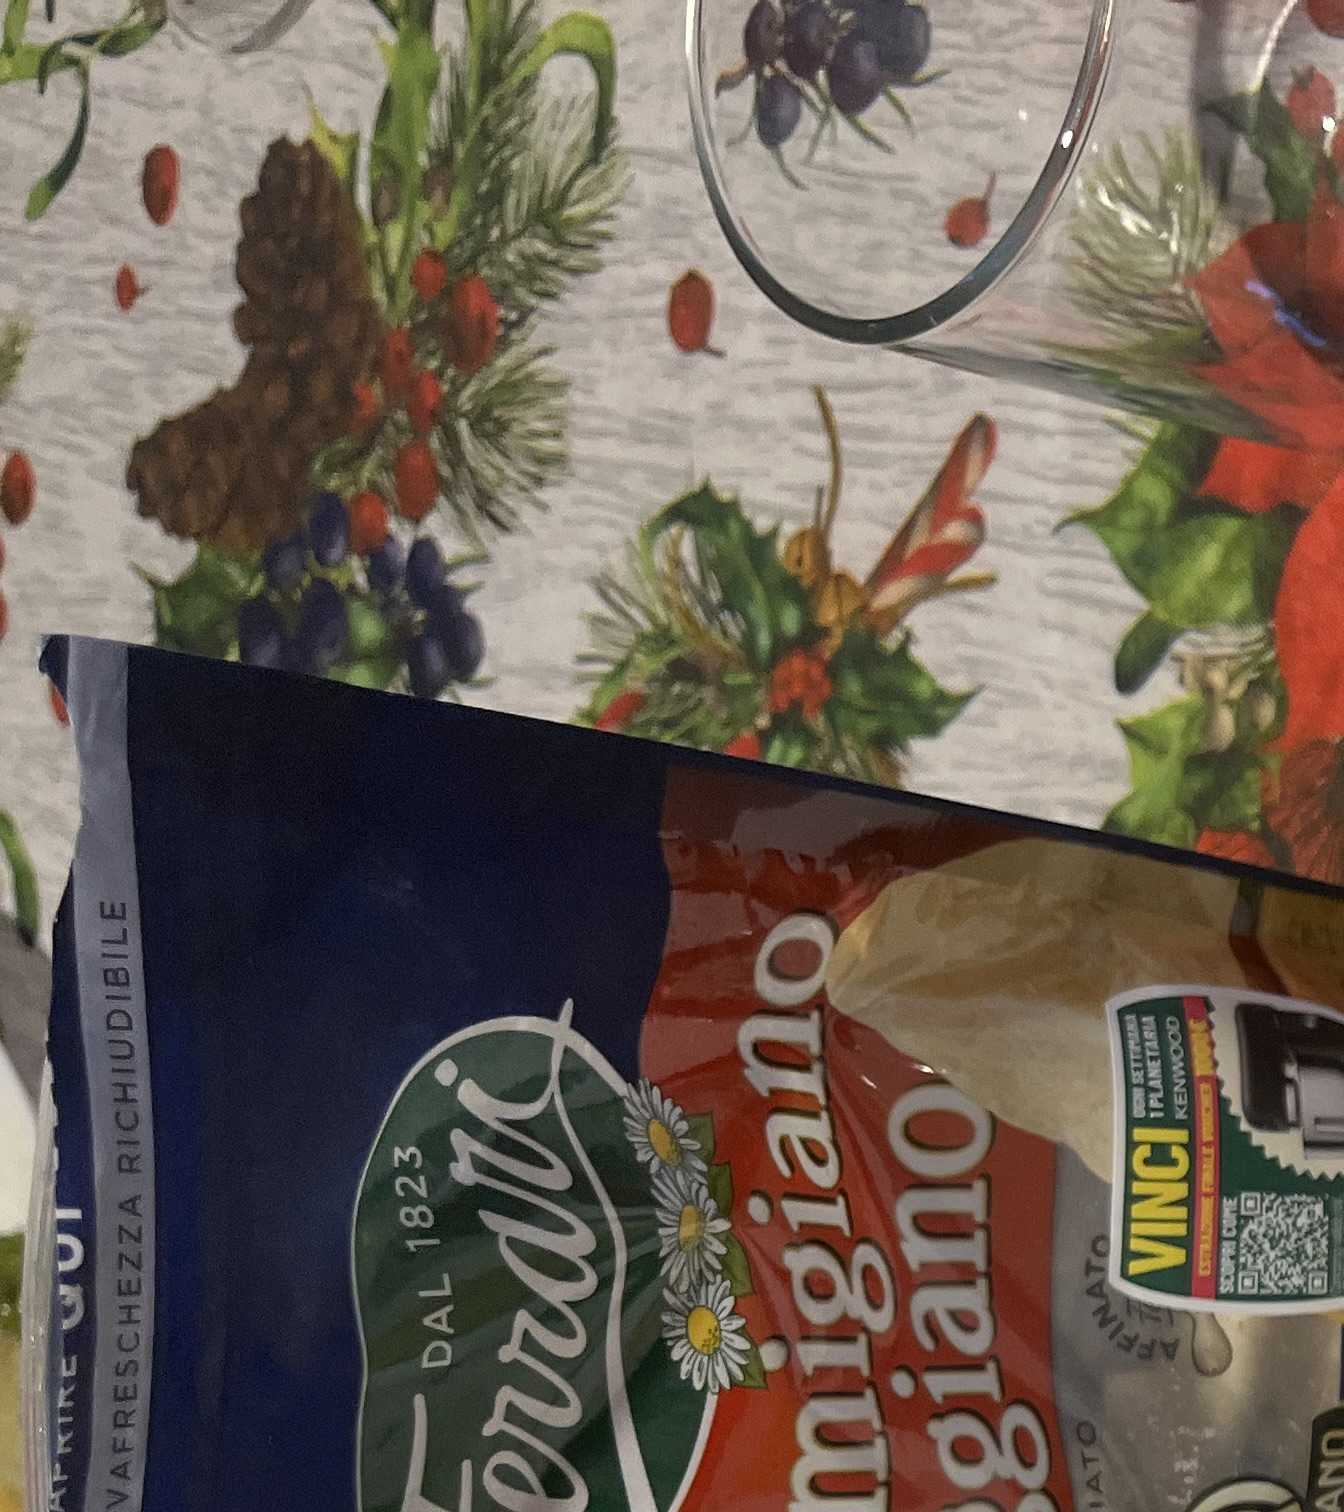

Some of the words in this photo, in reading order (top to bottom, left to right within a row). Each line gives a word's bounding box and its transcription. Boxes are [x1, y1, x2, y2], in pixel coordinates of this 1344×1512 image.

[98, 901, 143, 1177] RICHIUDIBILE
[1141, 1014, 1164, 1108] PLANETARIA
[1167, 1016, 1189, 1120] KENWOOD
[393, 1144, 441, 1251] 1823
[1128, 1126, 1190, 1276] VINCI
[1084, 1234, 1180, 1362] AFFINATO
[1221, 1238, 1237, 1293] SCOPRI
[419, 1273, 454, 1368] DAL
